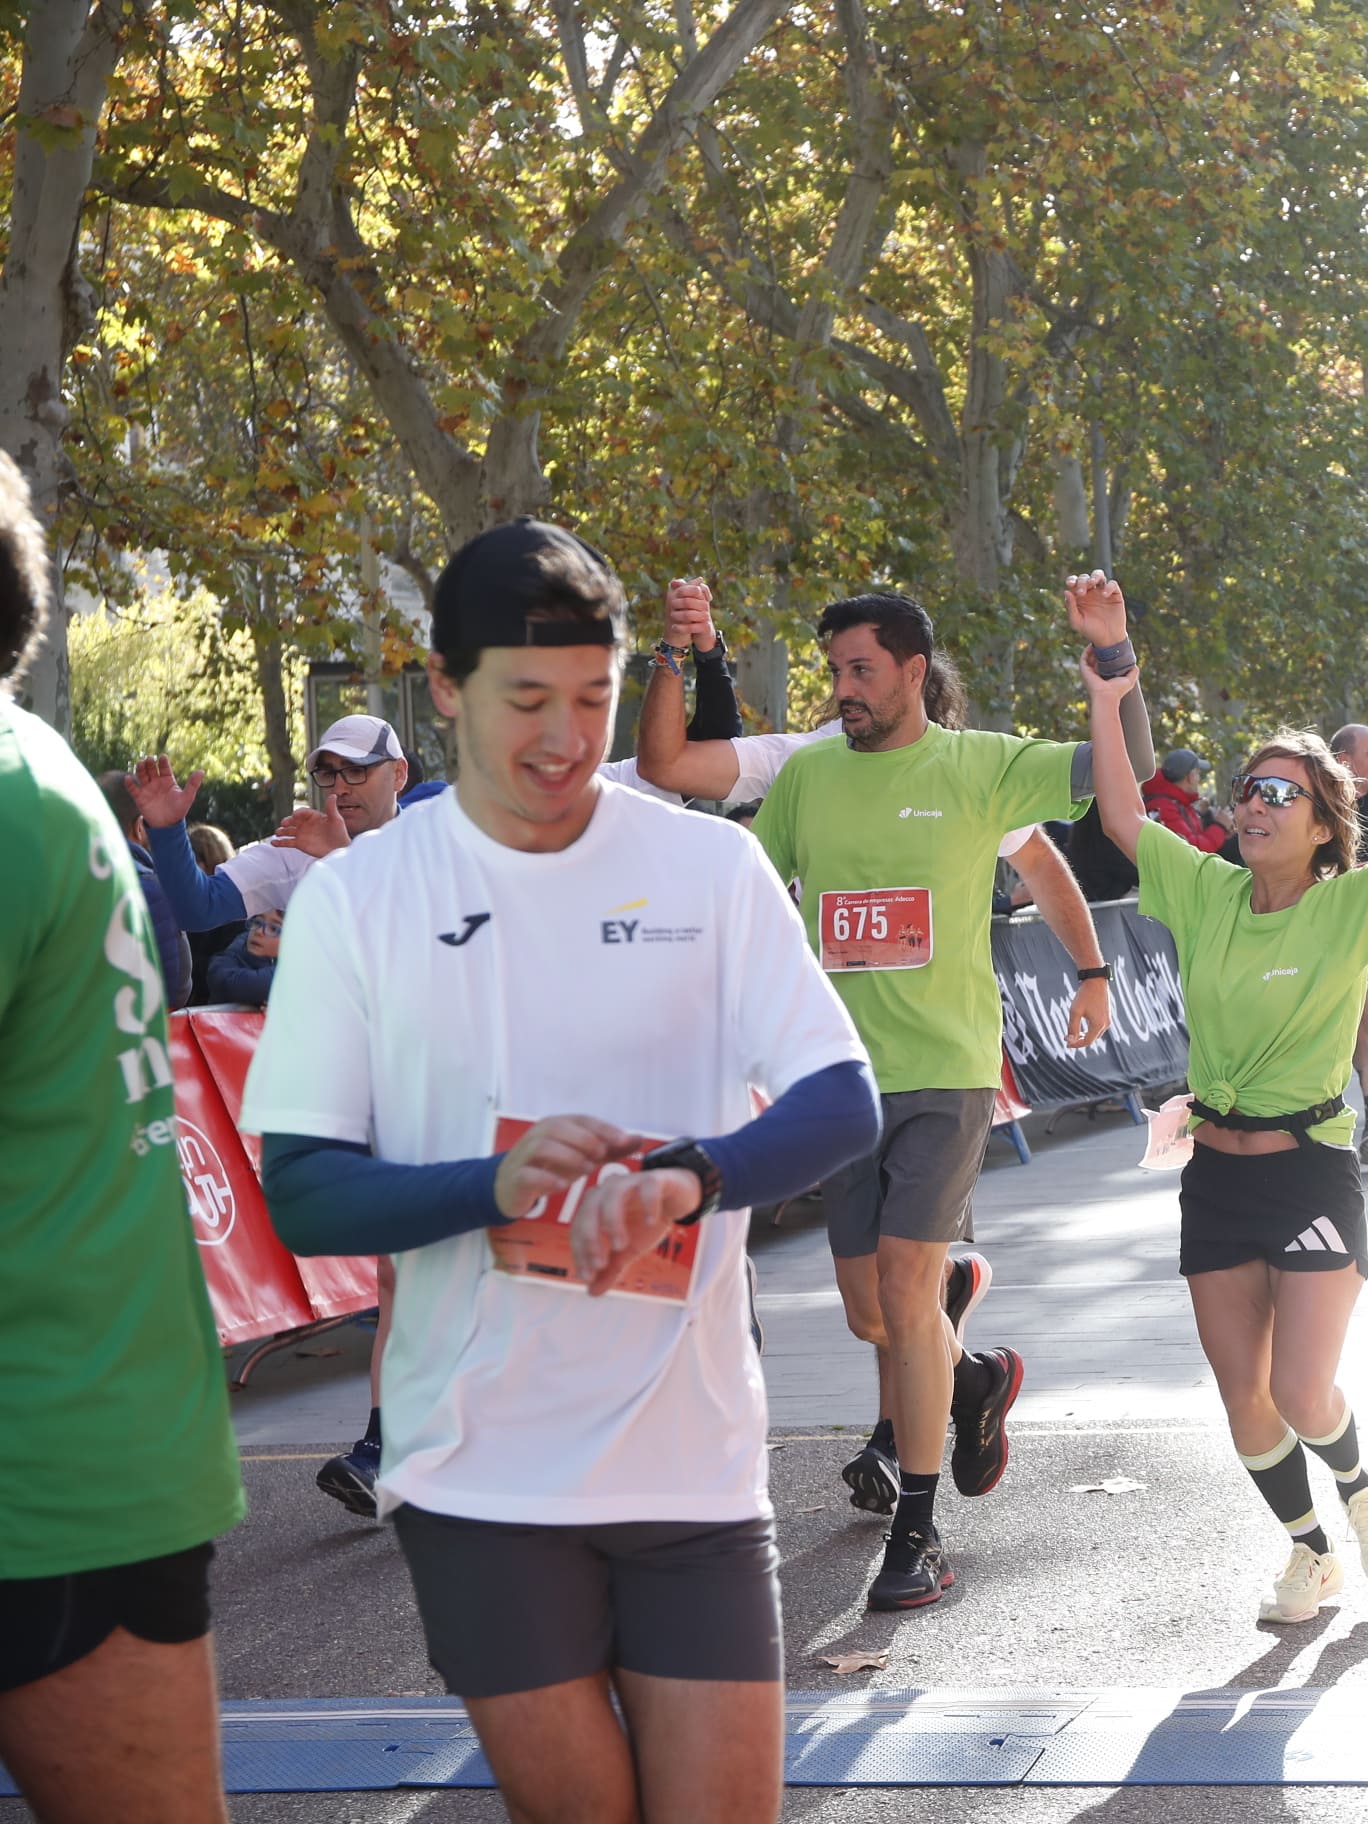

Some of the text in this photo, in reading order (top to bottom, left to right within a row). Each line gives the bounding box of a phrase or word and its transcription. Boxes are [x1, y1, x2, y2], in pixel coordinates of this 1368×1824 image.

[913, 808, 943, 819] Unicaja
[601, 919, 639, 943] EY
[833, 906, 888, 941] 675
